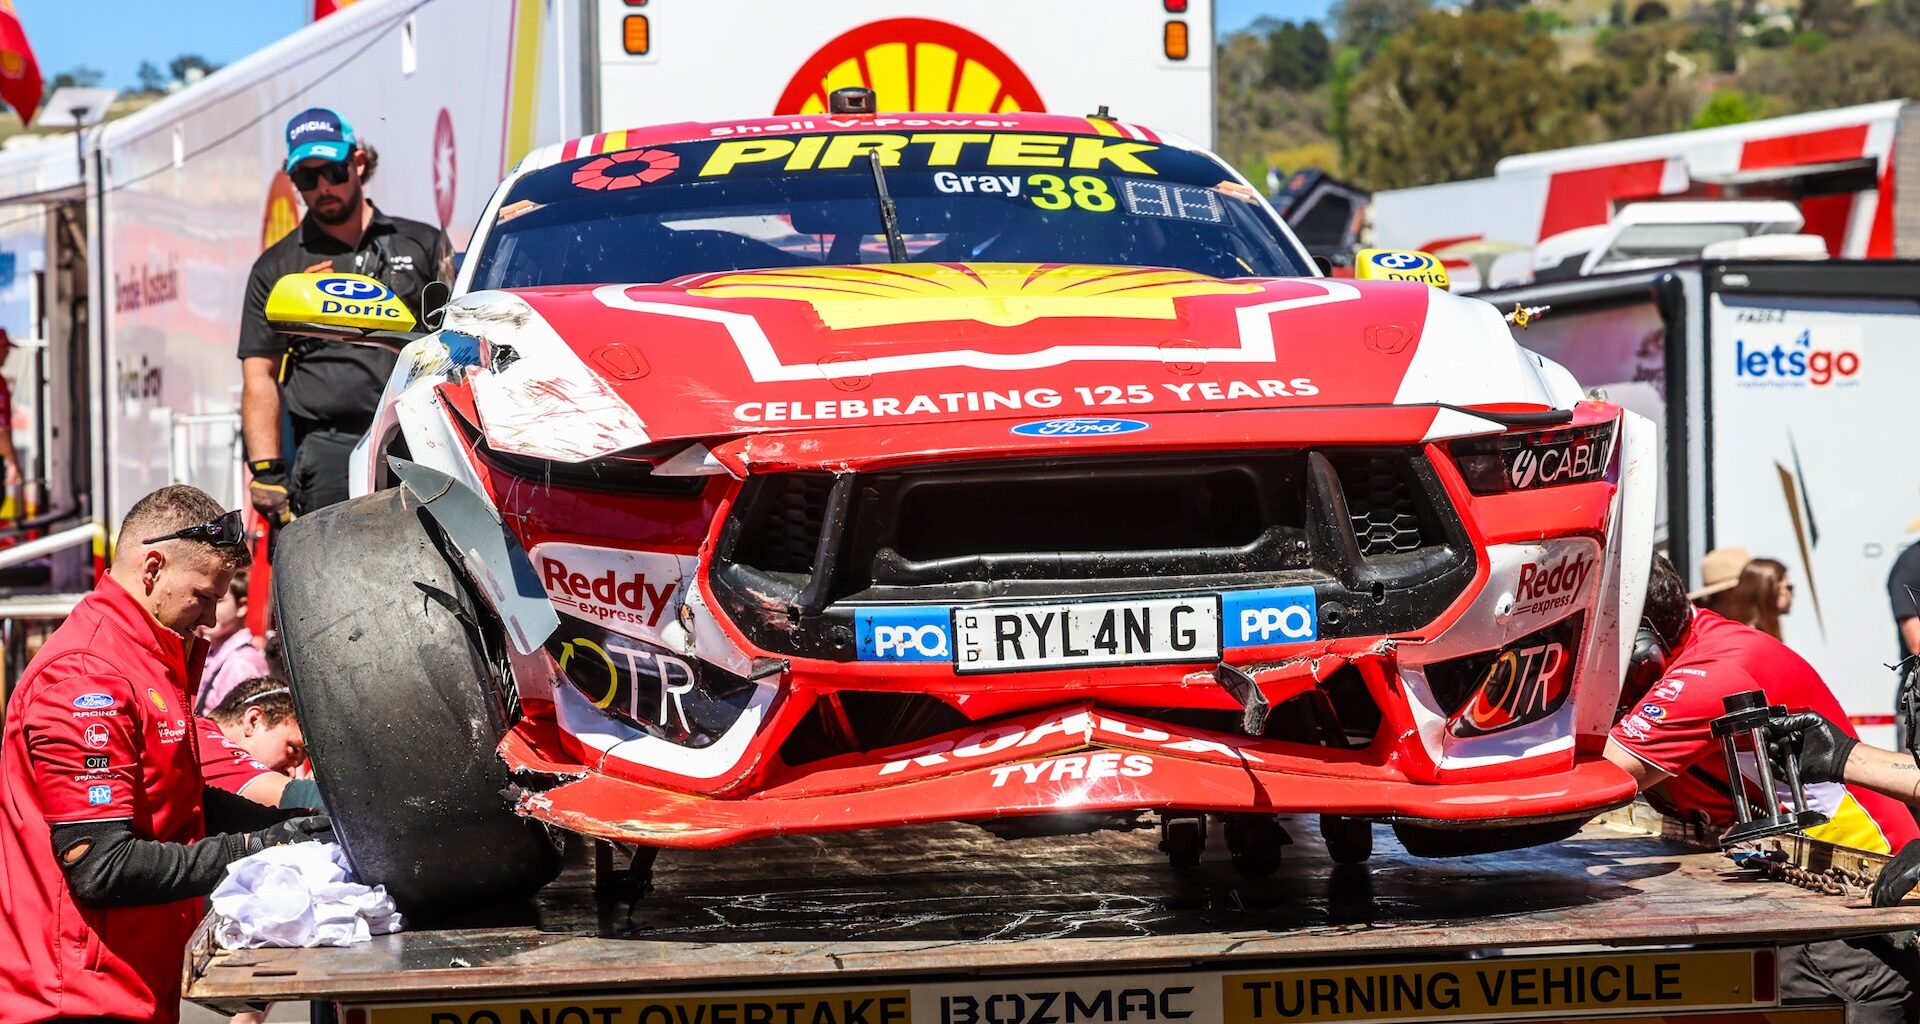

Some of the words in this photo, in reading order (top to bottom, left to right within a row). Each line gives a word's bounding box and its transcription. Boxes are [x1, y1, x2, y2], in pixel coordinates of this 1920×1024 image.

[290, 120, 335, 140] OFFICIAL
[710, 119, 815, 136] Shell
[826, 117, 1020, 130] V-Power
[698, 132, 1159, 176] PIRTEK
[933, 171, 1021, 198] Gray
[1027, 174, 1116, 212] 38
[321, 300, 401, 318] Doric
[733, 388, 1059, 422] CELEBRATING
[1073, 384, 1154, 407] 125
[1161, 377, 1320, 402] YEARS
[1038, 418, 1122, 435] Ford
[543, 557, 677, 627] Reddy
[1516, 553, 1595, 604] Reddy
[579, 602, 643, 625] express
[1532, 594, 1570, 615] express
[995, 607, 1151, 661] RYL4N
[1170, 605, 1196, 652] G
[1240, 605, 1312, 642] PPQ
[875, 624, 948, 658] PPQ
[560, 638, 694, 734] OTR
[1472, 642, 1562, 723] OTR
[72, 709, 118, 718] RACING
[81, 694, 107, 707] Ford
[158, 728, 186, 738] V-Power
[879, 710, 1264, 776] ROADX
[86, 757, 109, 768] OTR
[990, 753, 1154, 788] TYRES
[89, 787, 112, 804] PPG
[940, 987, 1195, 1024] BOZMAC
[1243, 972, 1461, 1018] TURNING
[1476, 964, 1683, 1006] VEHICLE
